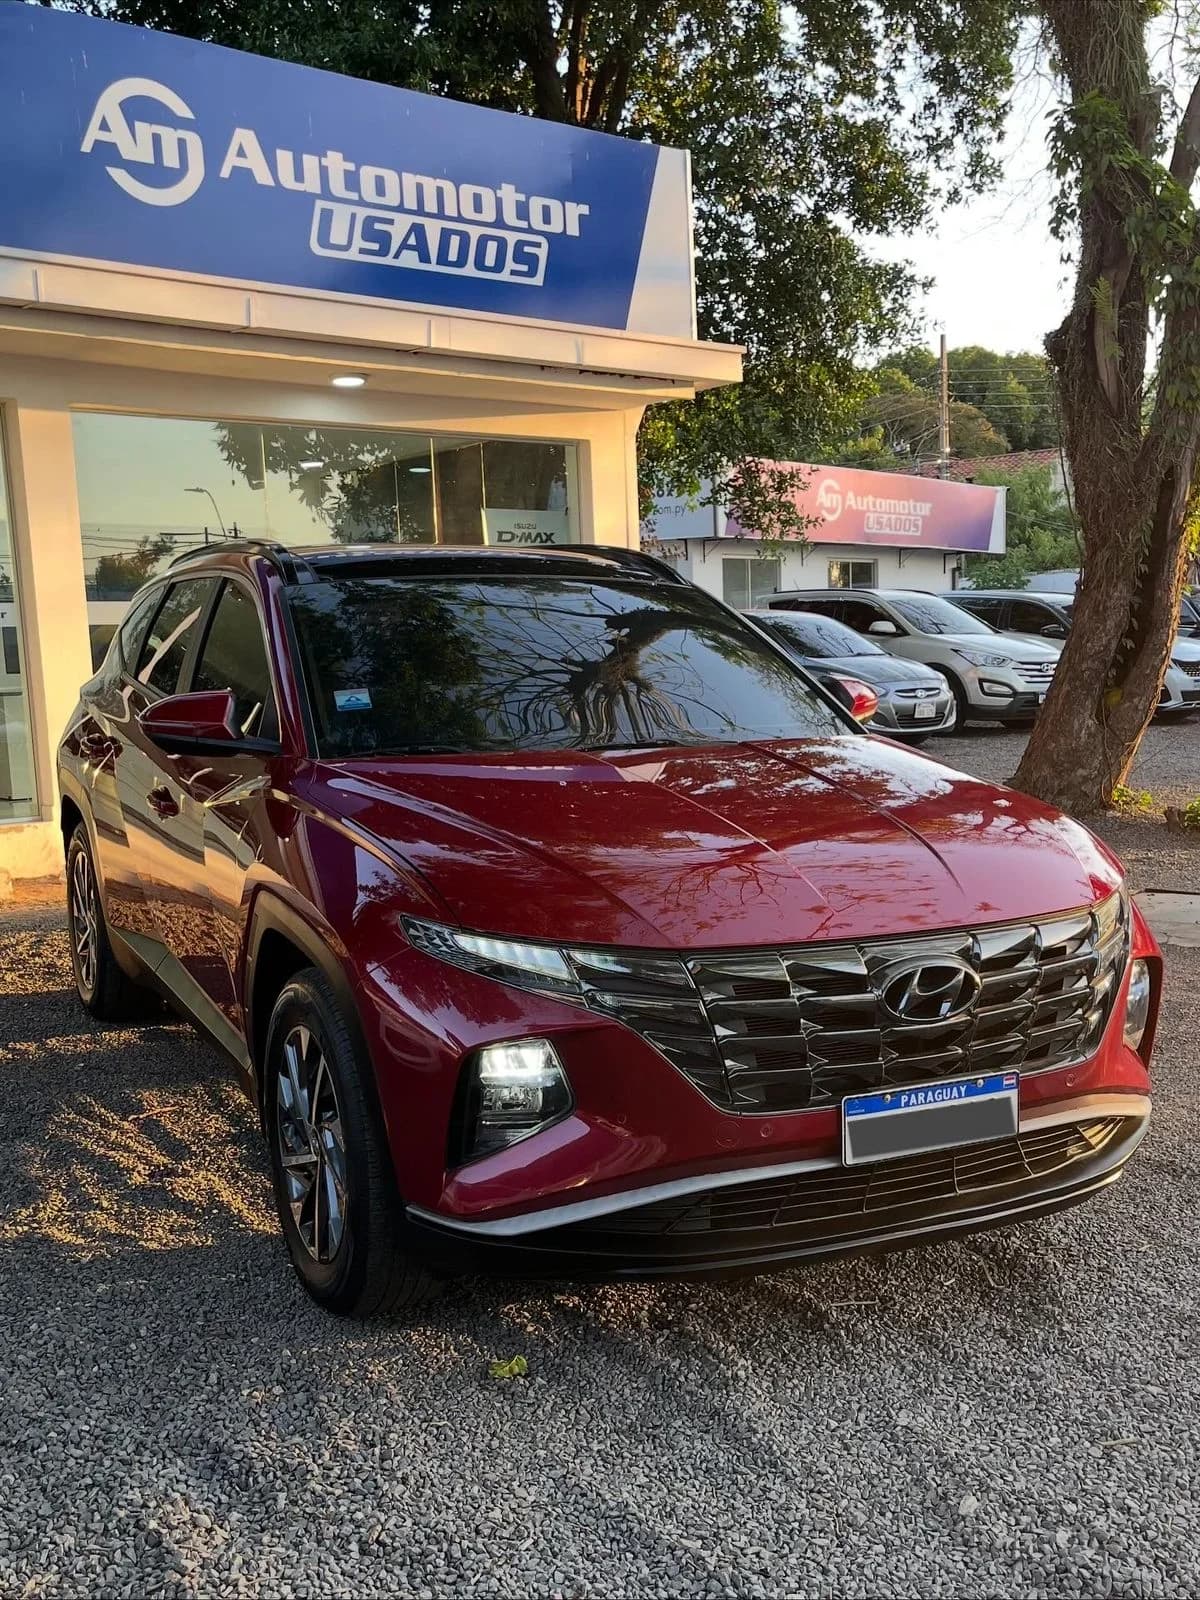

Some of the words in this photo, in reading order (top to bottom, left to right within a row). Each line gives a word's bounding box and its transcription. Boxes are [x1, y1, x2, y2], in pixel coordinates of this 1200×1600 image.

[219, 127, 590, 237] Automotor
[317, 207, 543, 278] USADOS
[845, 491, 933, 516] Automotor
[865, 513, 921, 533] USADOS
[901, 1085, 967, 1107] PARAGUAY
